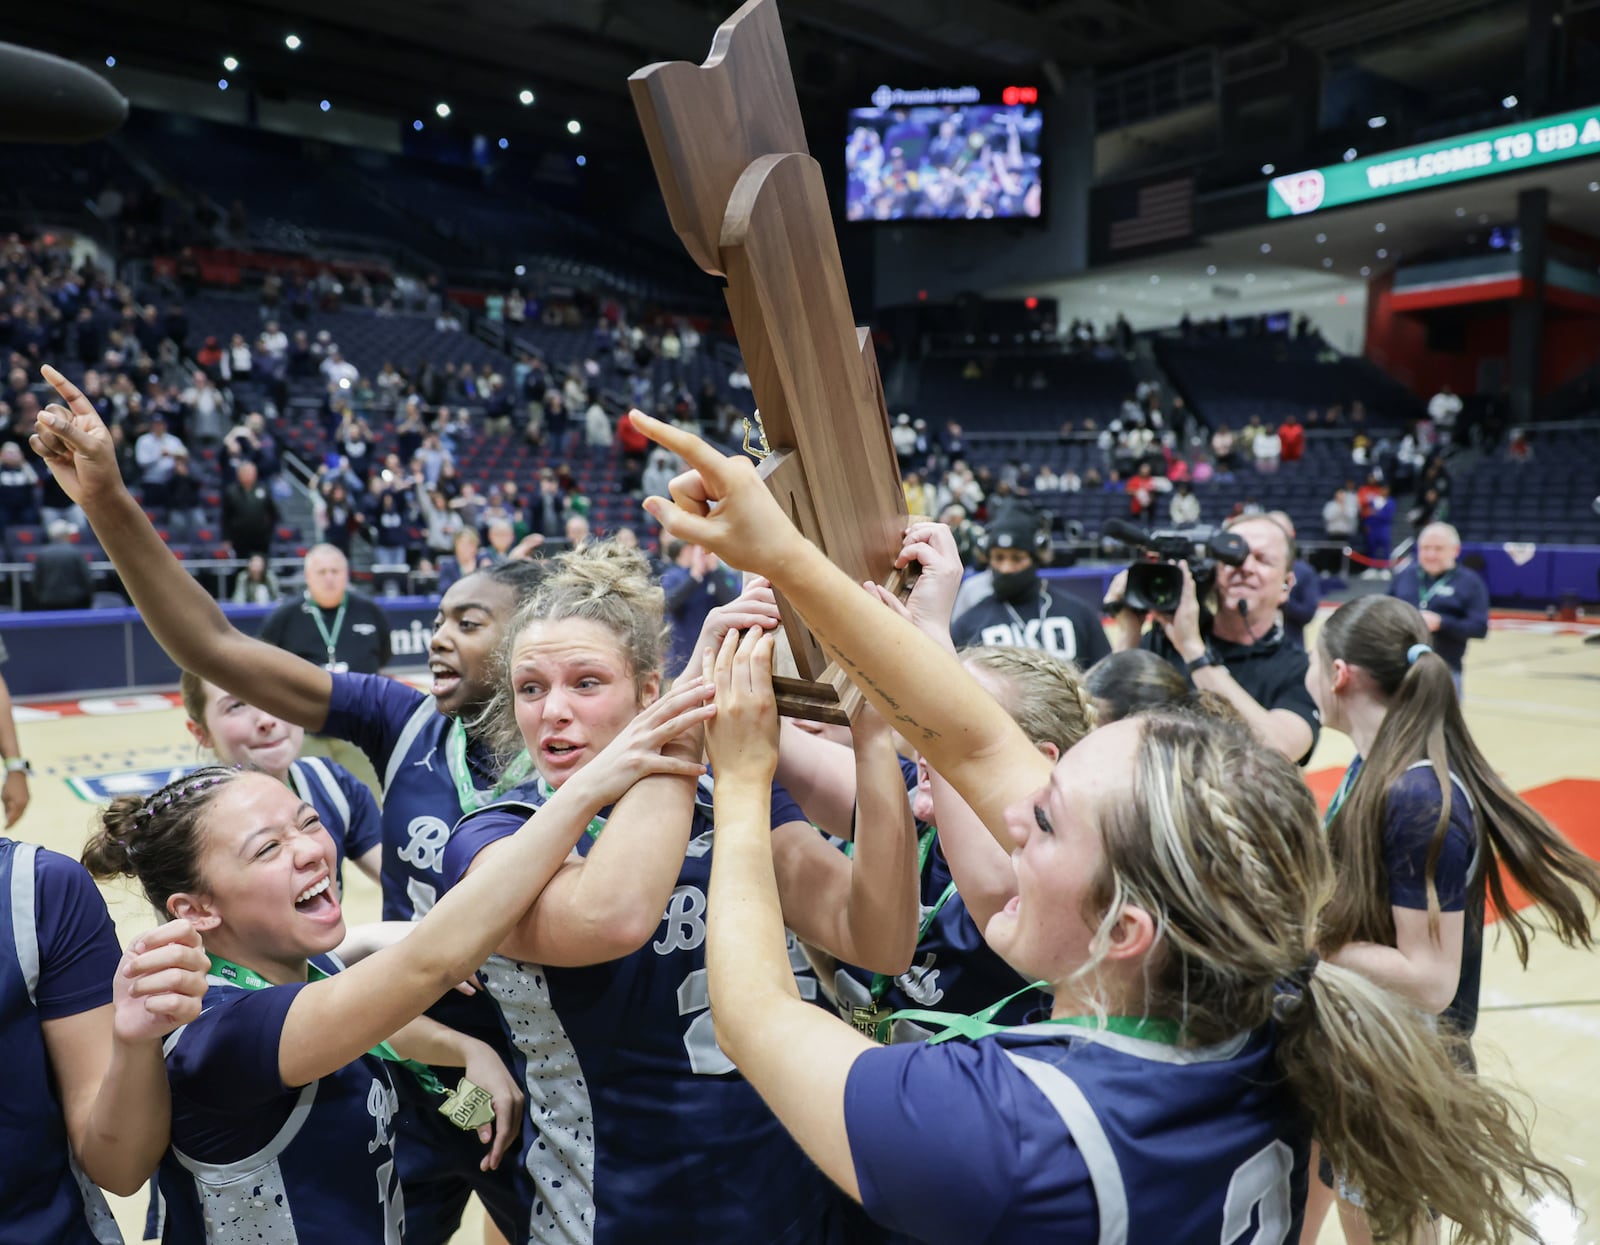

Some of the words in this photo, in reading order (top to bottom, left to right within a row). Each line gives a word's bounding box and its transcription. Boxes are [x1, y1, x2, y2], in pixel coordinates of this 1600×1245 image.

[1366, 141, 1492, 188] WELCOME
[1494, 132, 1533, 161] TO
[1535, 123, 1578, 152] UD
